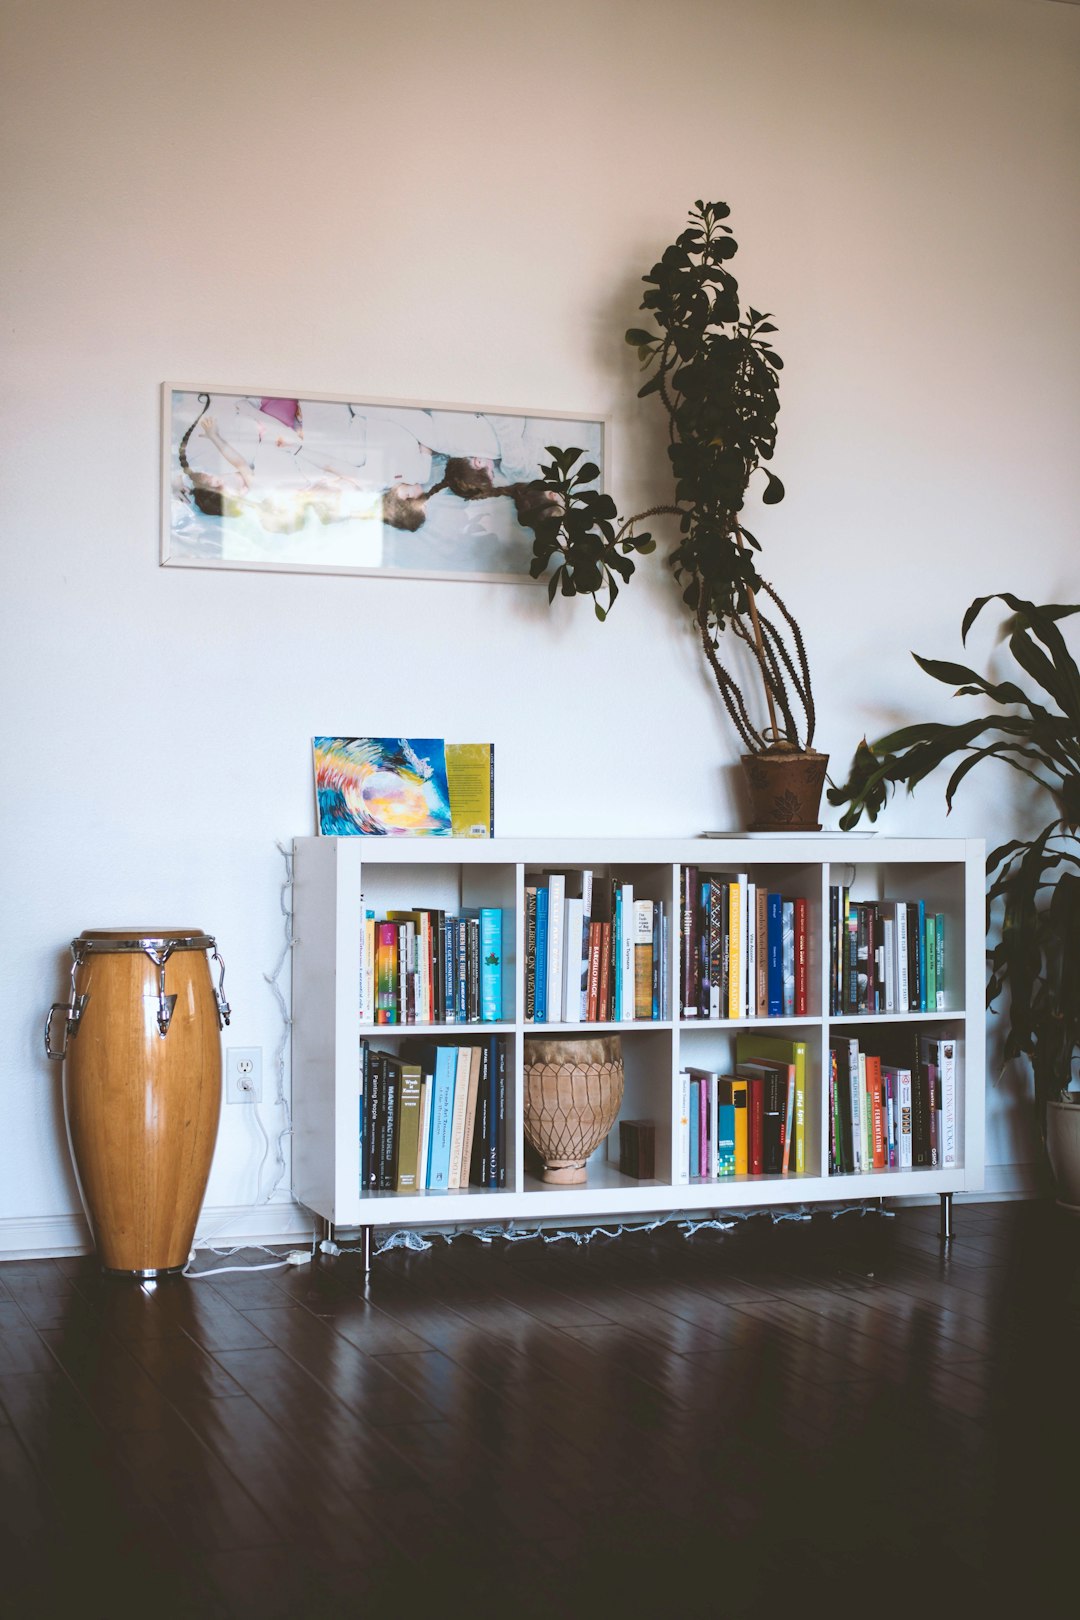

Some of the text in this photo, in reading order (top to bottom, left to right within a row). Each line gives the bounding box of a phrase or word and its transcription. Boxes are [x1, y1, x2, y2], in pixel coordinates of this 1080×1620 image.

[684, 910, 692, 935] kilim
[528, 956, 535, 969] ON
[386, 1086, 394, 1160] MANUFRACTURED
[795, 1110, 804, 1126] Judy
